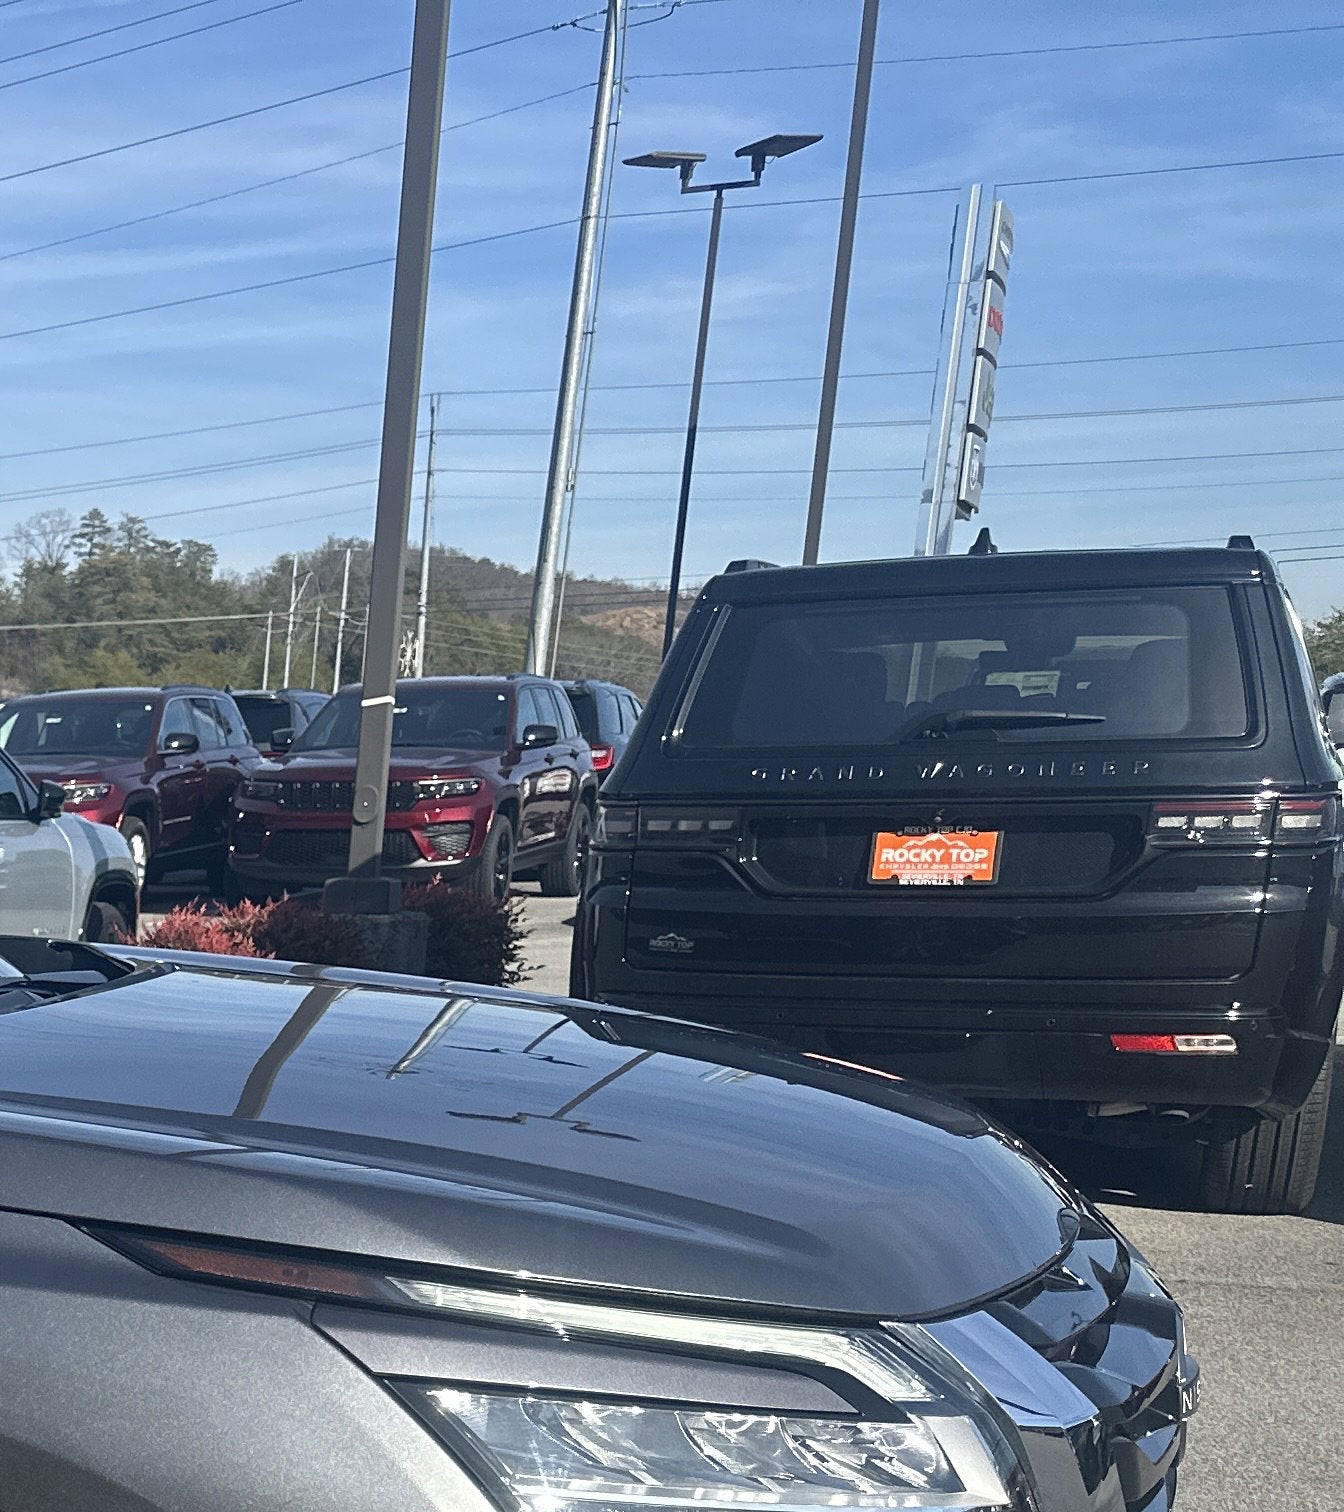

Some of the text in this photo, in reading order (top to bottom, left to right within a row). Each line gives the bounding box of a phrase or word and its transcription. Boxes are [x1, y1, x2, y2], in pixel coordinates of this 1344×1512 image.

[750, 760, 1150, 782] GRAND WAGONEER
[880, 848, 989, 863] ROCKY TOP
